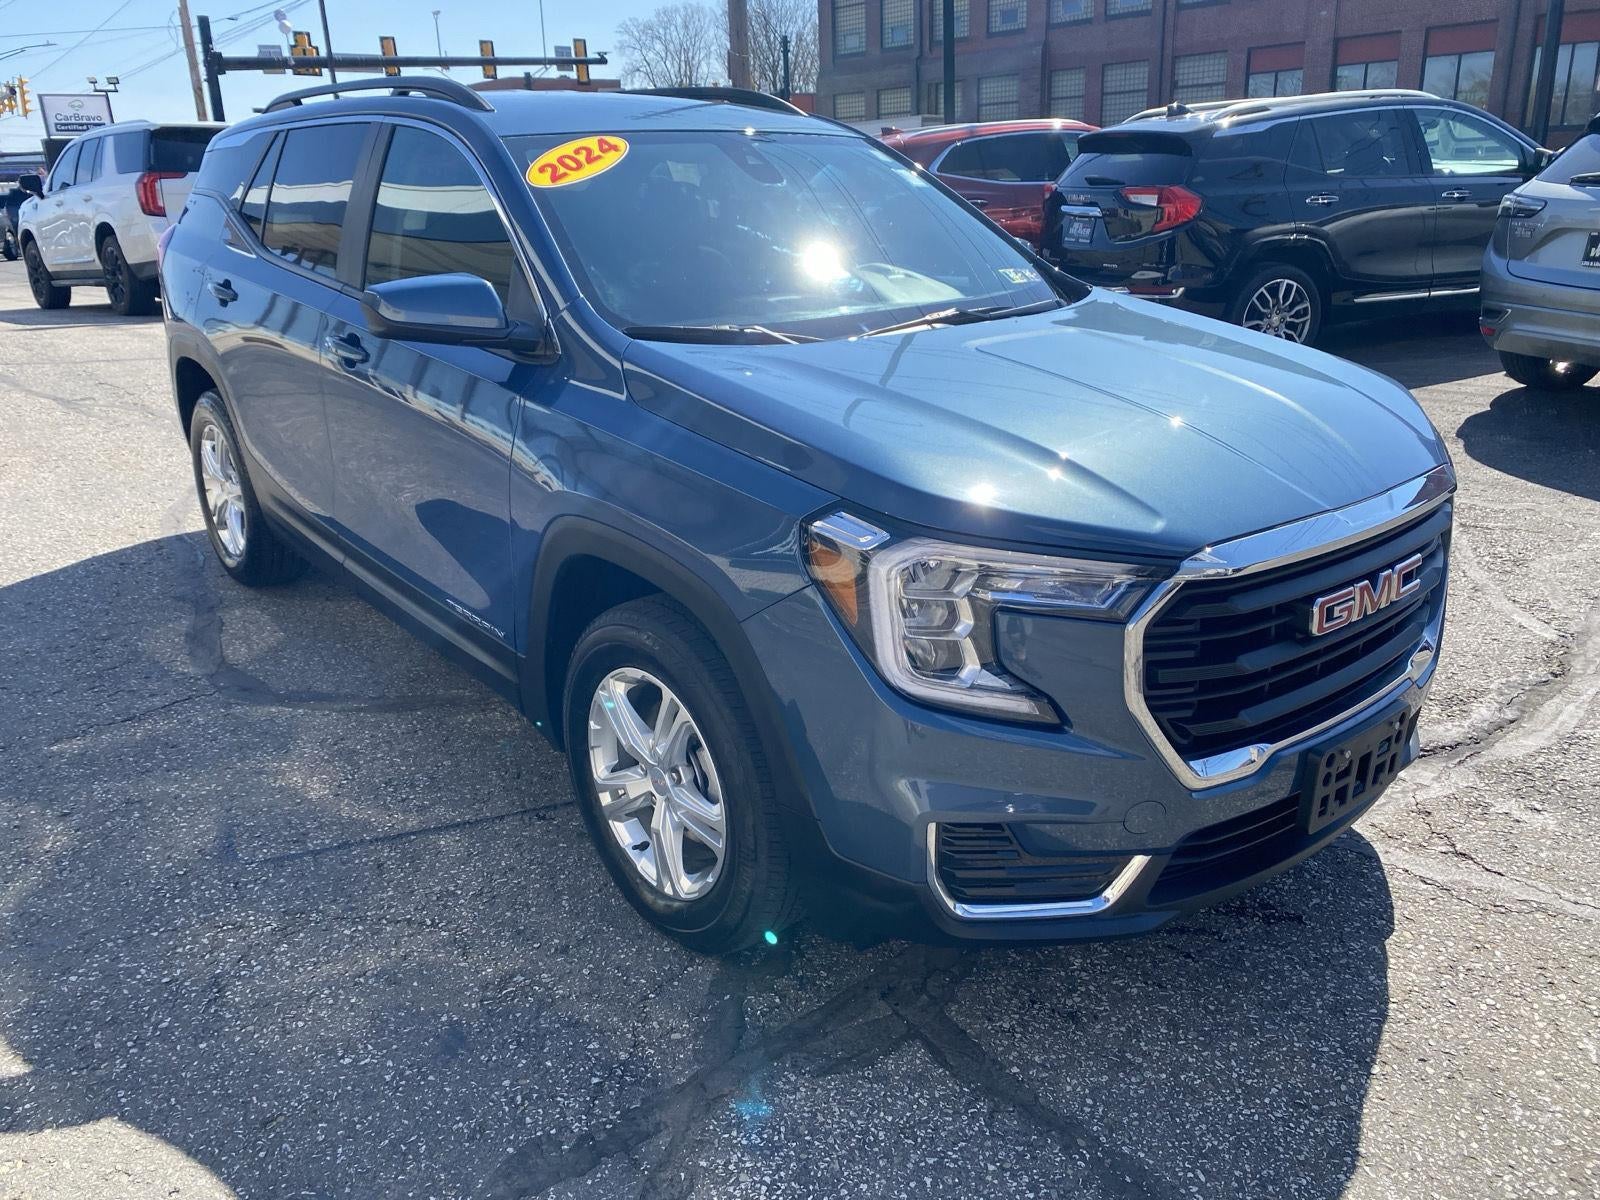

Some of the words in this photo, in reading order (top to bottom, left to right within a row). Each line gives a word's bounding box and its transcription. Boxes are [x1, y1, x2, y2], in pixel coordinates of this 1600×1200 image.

[54, 112, 103, 122] CarBravo
[537, 137, 620, 184] 2024
[1311, 553, 1422, 635] GMC
